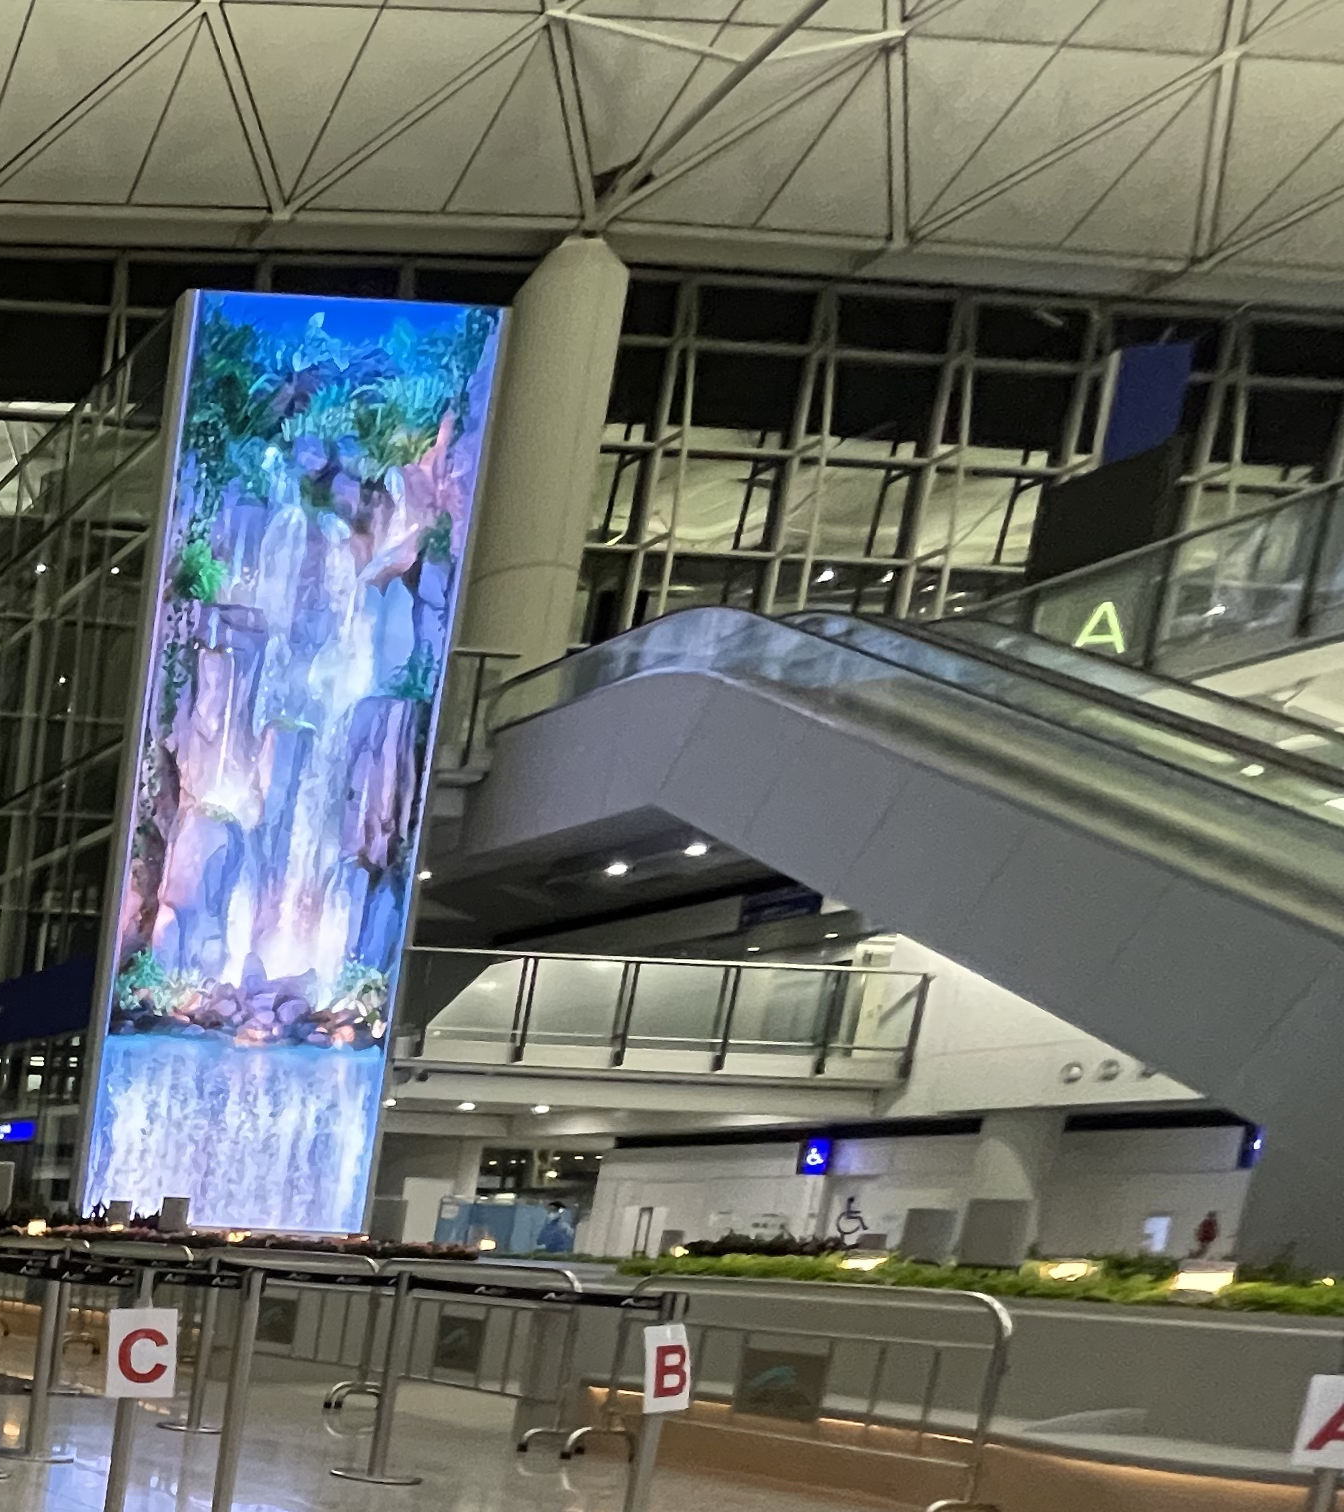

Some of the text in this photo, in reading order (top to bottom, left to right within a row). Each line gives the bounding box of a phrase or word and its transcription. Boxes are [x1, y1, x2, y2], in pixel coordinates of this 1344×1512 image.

[1075, 601, 1125, 654] A
[118, 1328, 168, 1384] C
[654, 1345, 688, 1398] B
